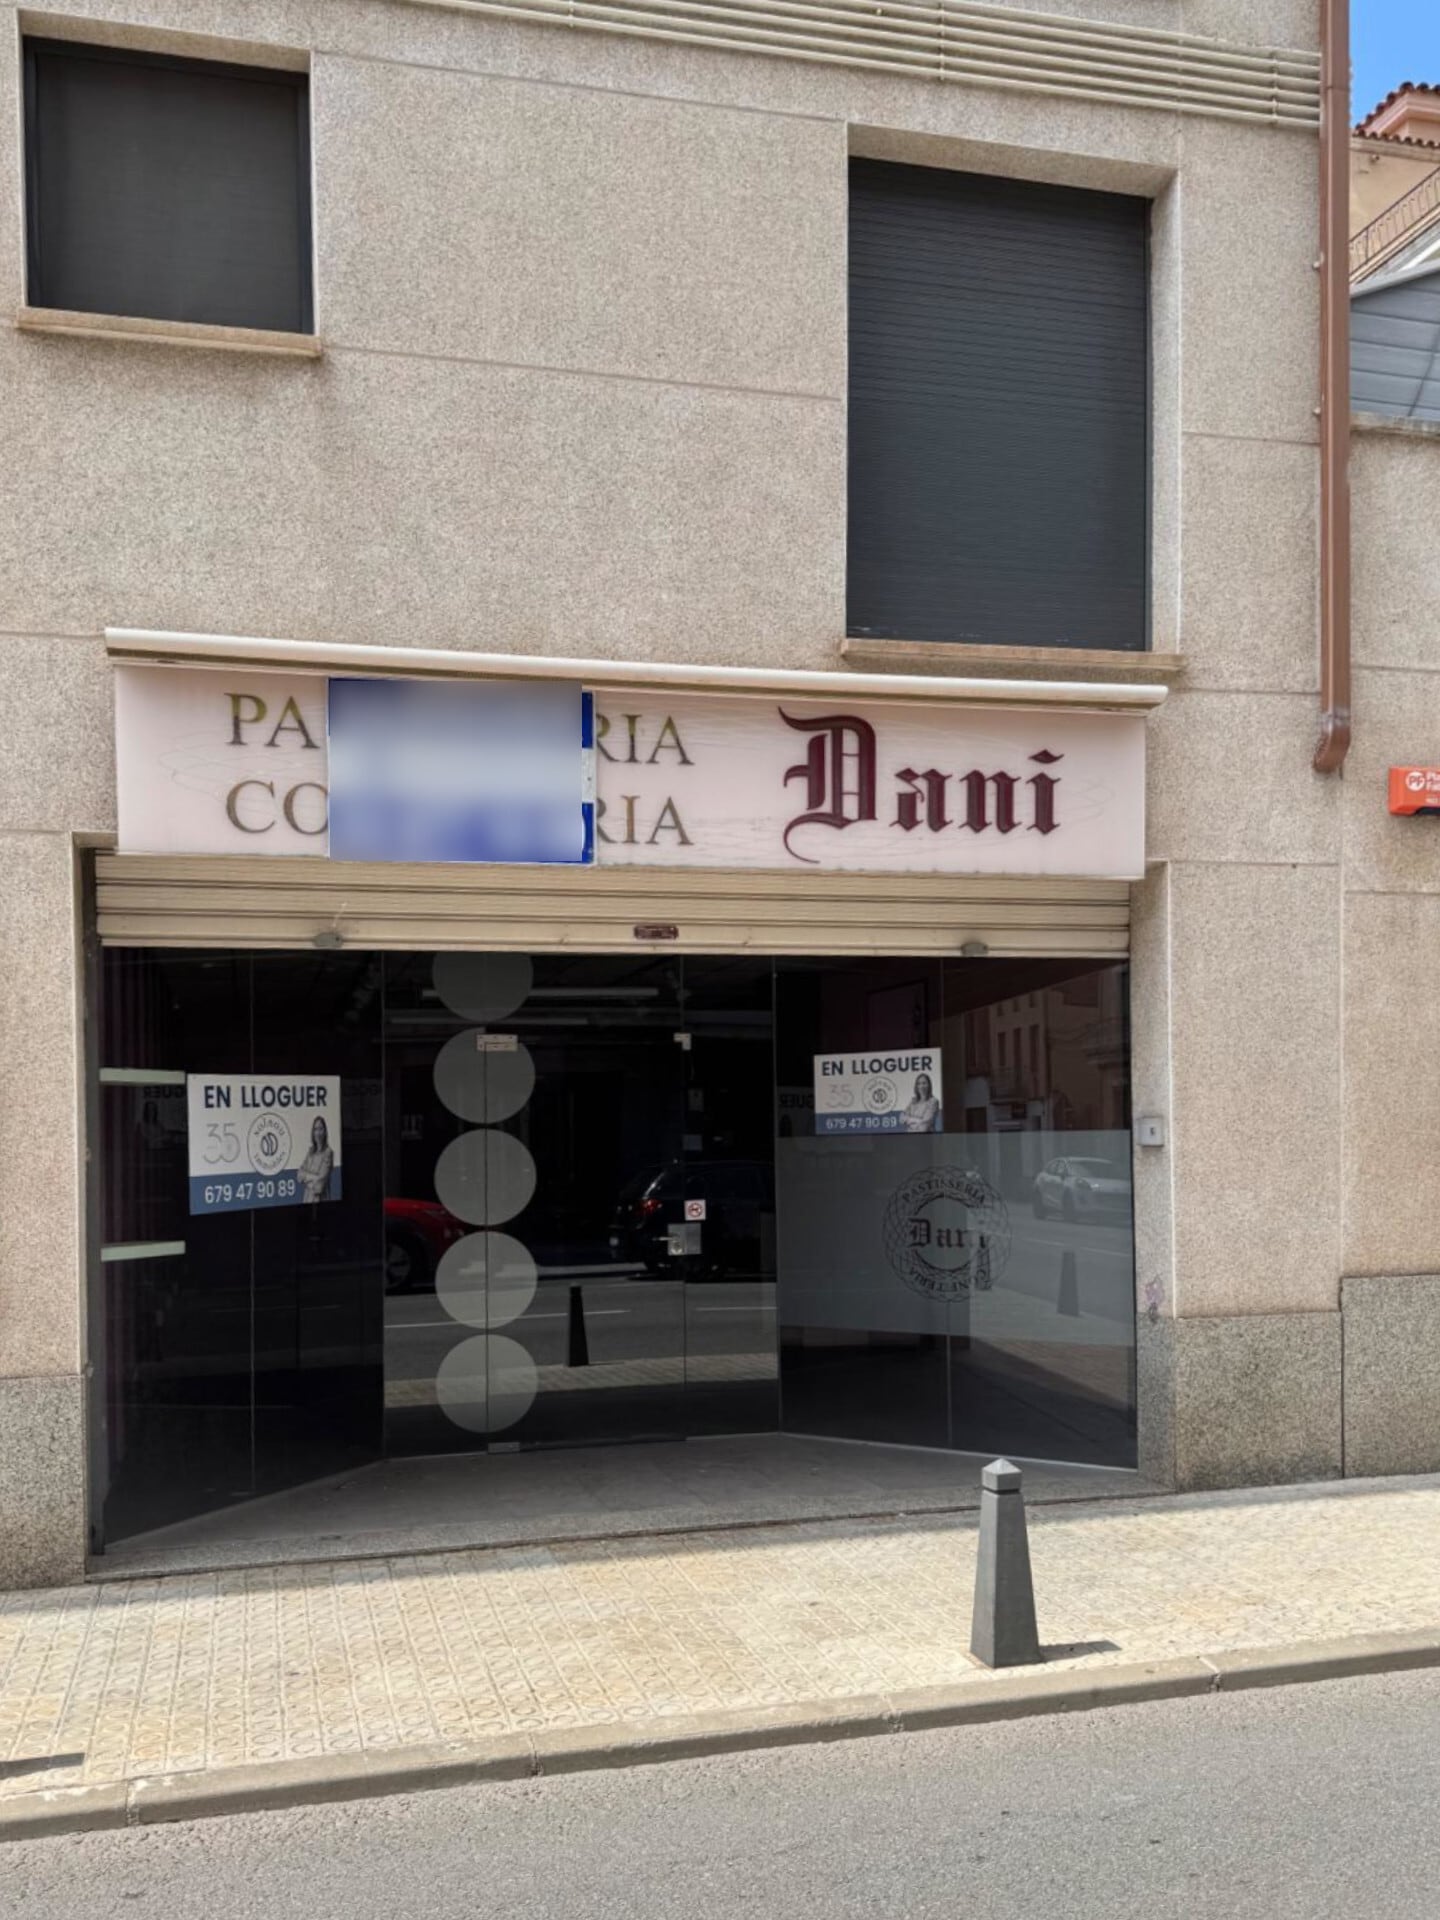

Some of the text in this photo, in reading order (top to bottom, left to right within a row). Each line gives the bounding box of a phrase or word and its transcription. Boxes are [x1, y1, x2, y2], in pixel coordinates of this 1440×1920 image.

[776, 706, 1065, 864] Dani
[822, 1056, 933, 1076] EN LLOGUER
[204, 1085, 231, 1109] EN
[241, 1085, 327, 1108] LLOGUER
[203, 1122, 241, 1164] 35
[204, 1179, 296, 1204] 679 47 90 89
